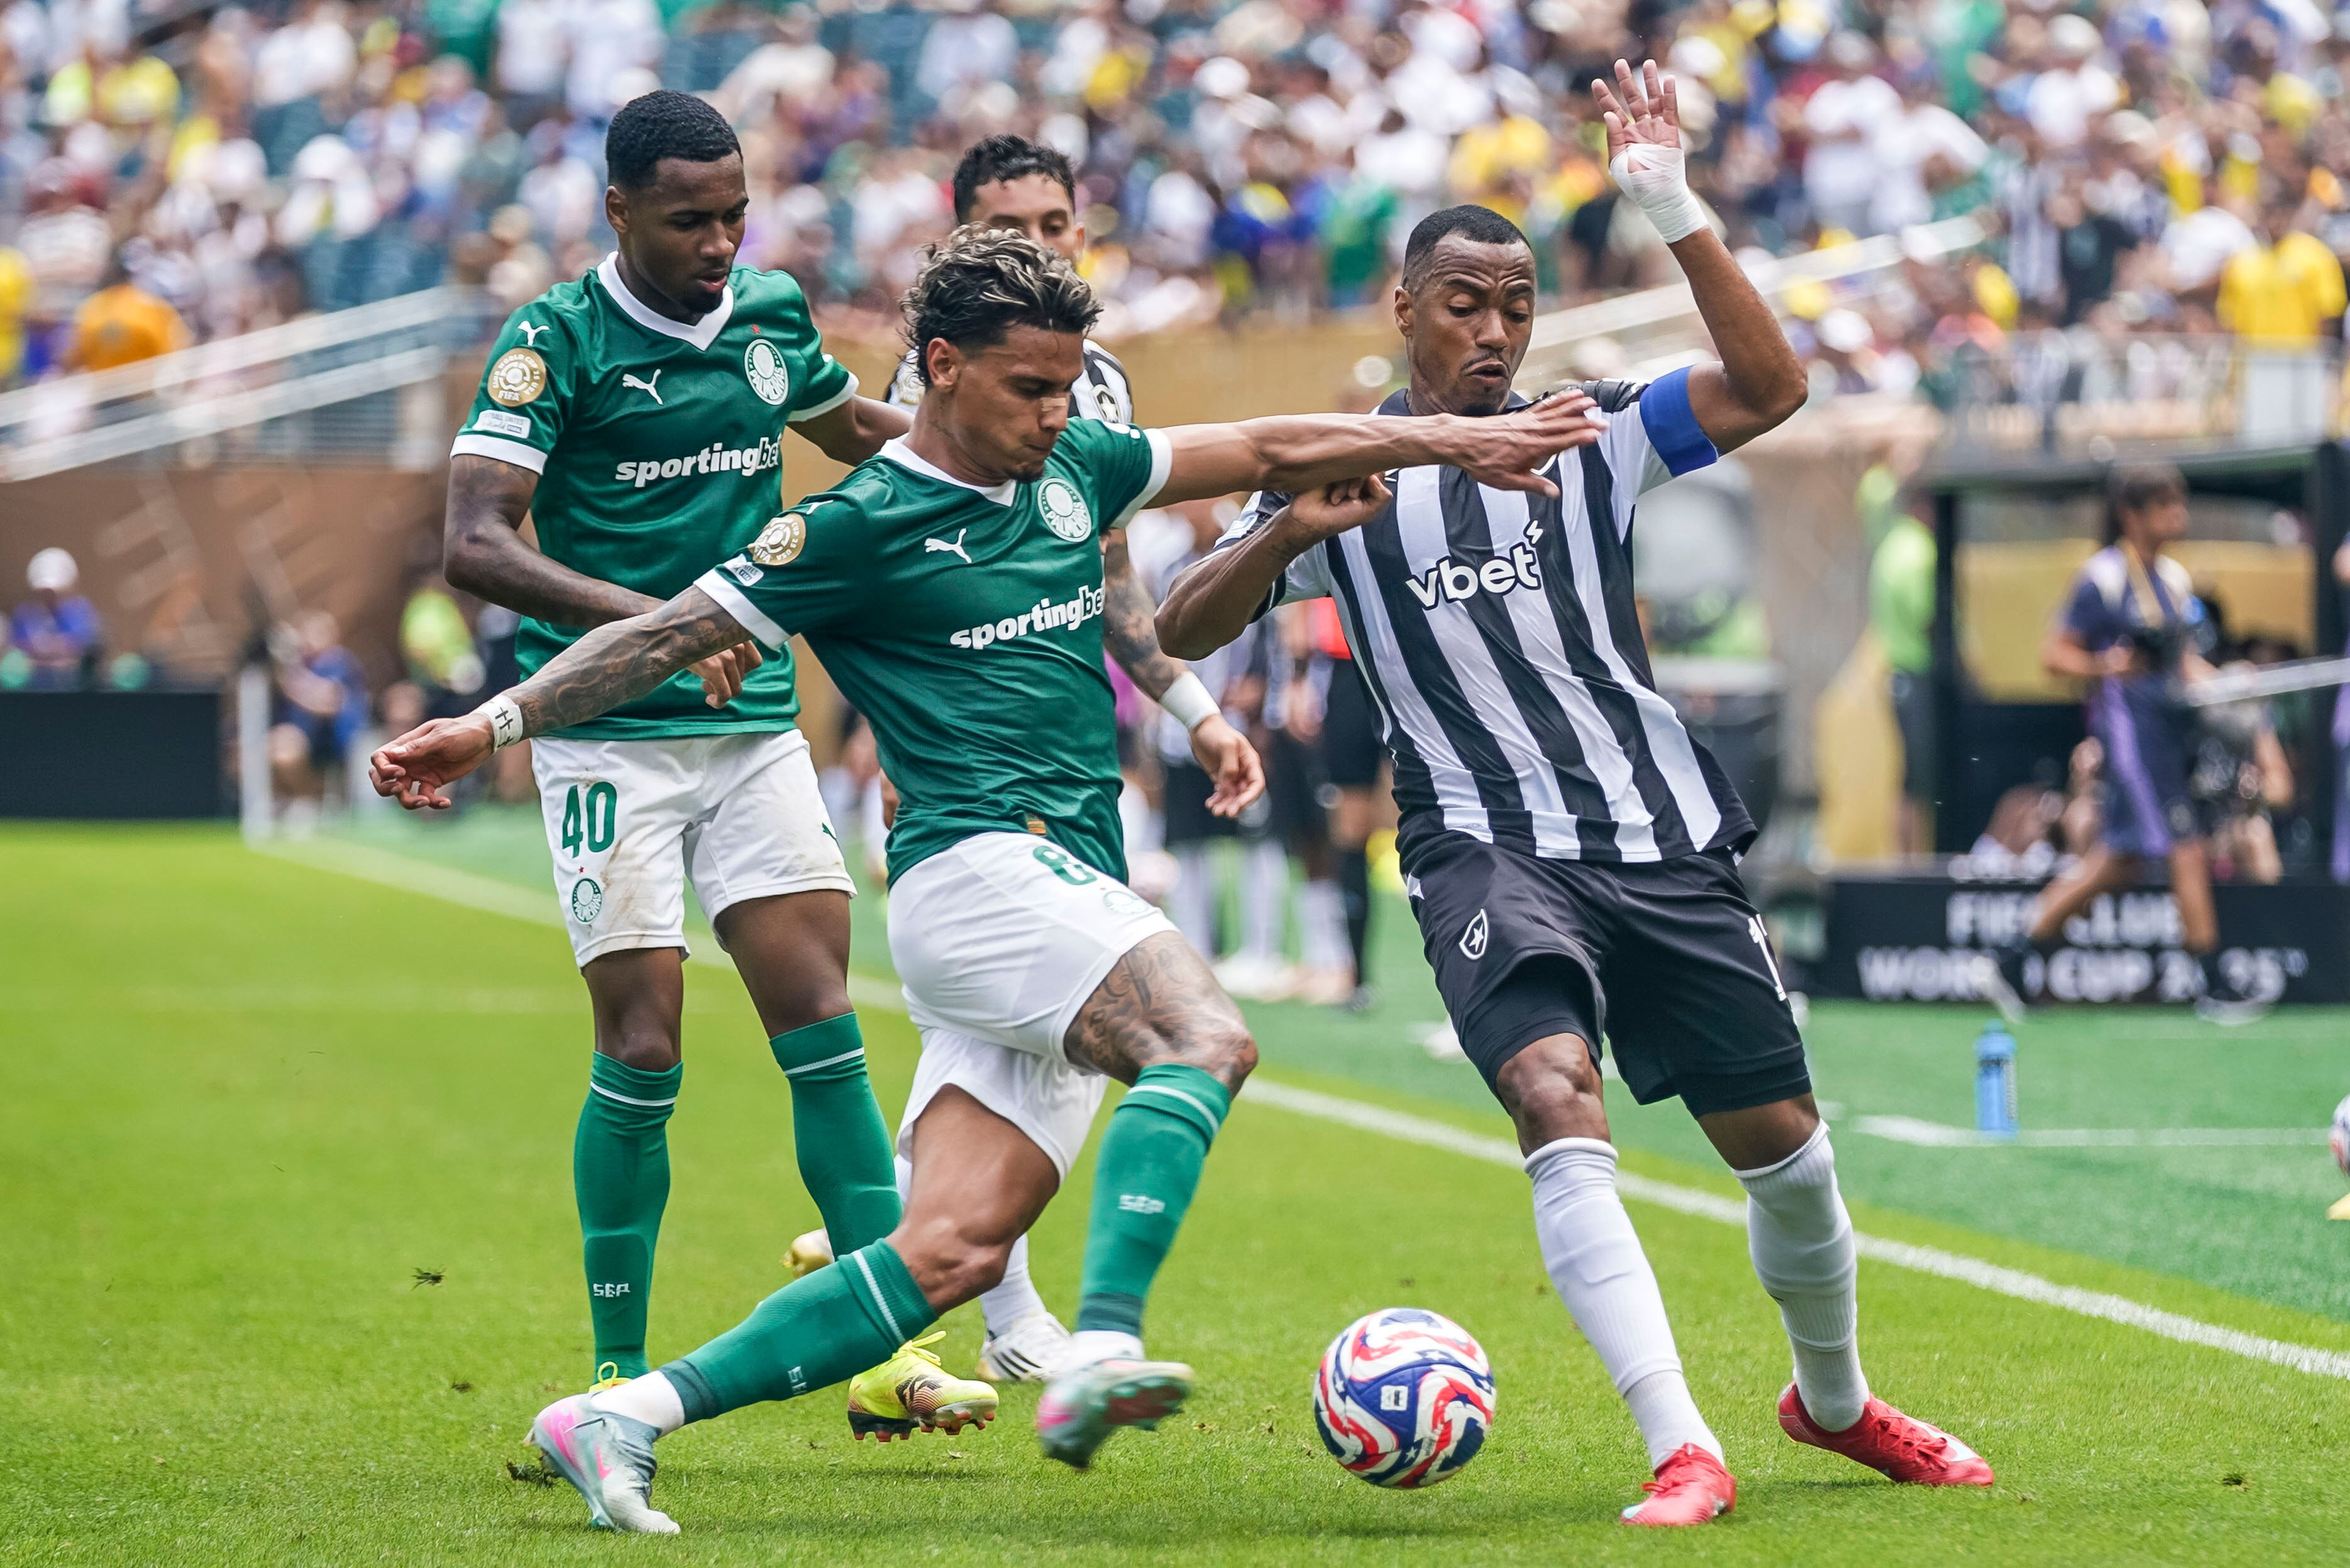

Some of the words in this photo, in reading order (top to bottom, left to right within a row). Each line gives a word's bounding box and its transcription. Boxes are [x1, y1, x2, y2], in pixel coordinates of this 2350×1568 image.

[498, 390, 520, 401] FIFA
[1405, 544, 1539, 608] vbet
[949, 575, 1106, 650] sportingbe
[561, 781, 617, 859] 40
[1748, 913, 1787, 1001] 1
[2047, 945, 2155, 1002] CUP
[593, 1283, 631, 1298] SEP
